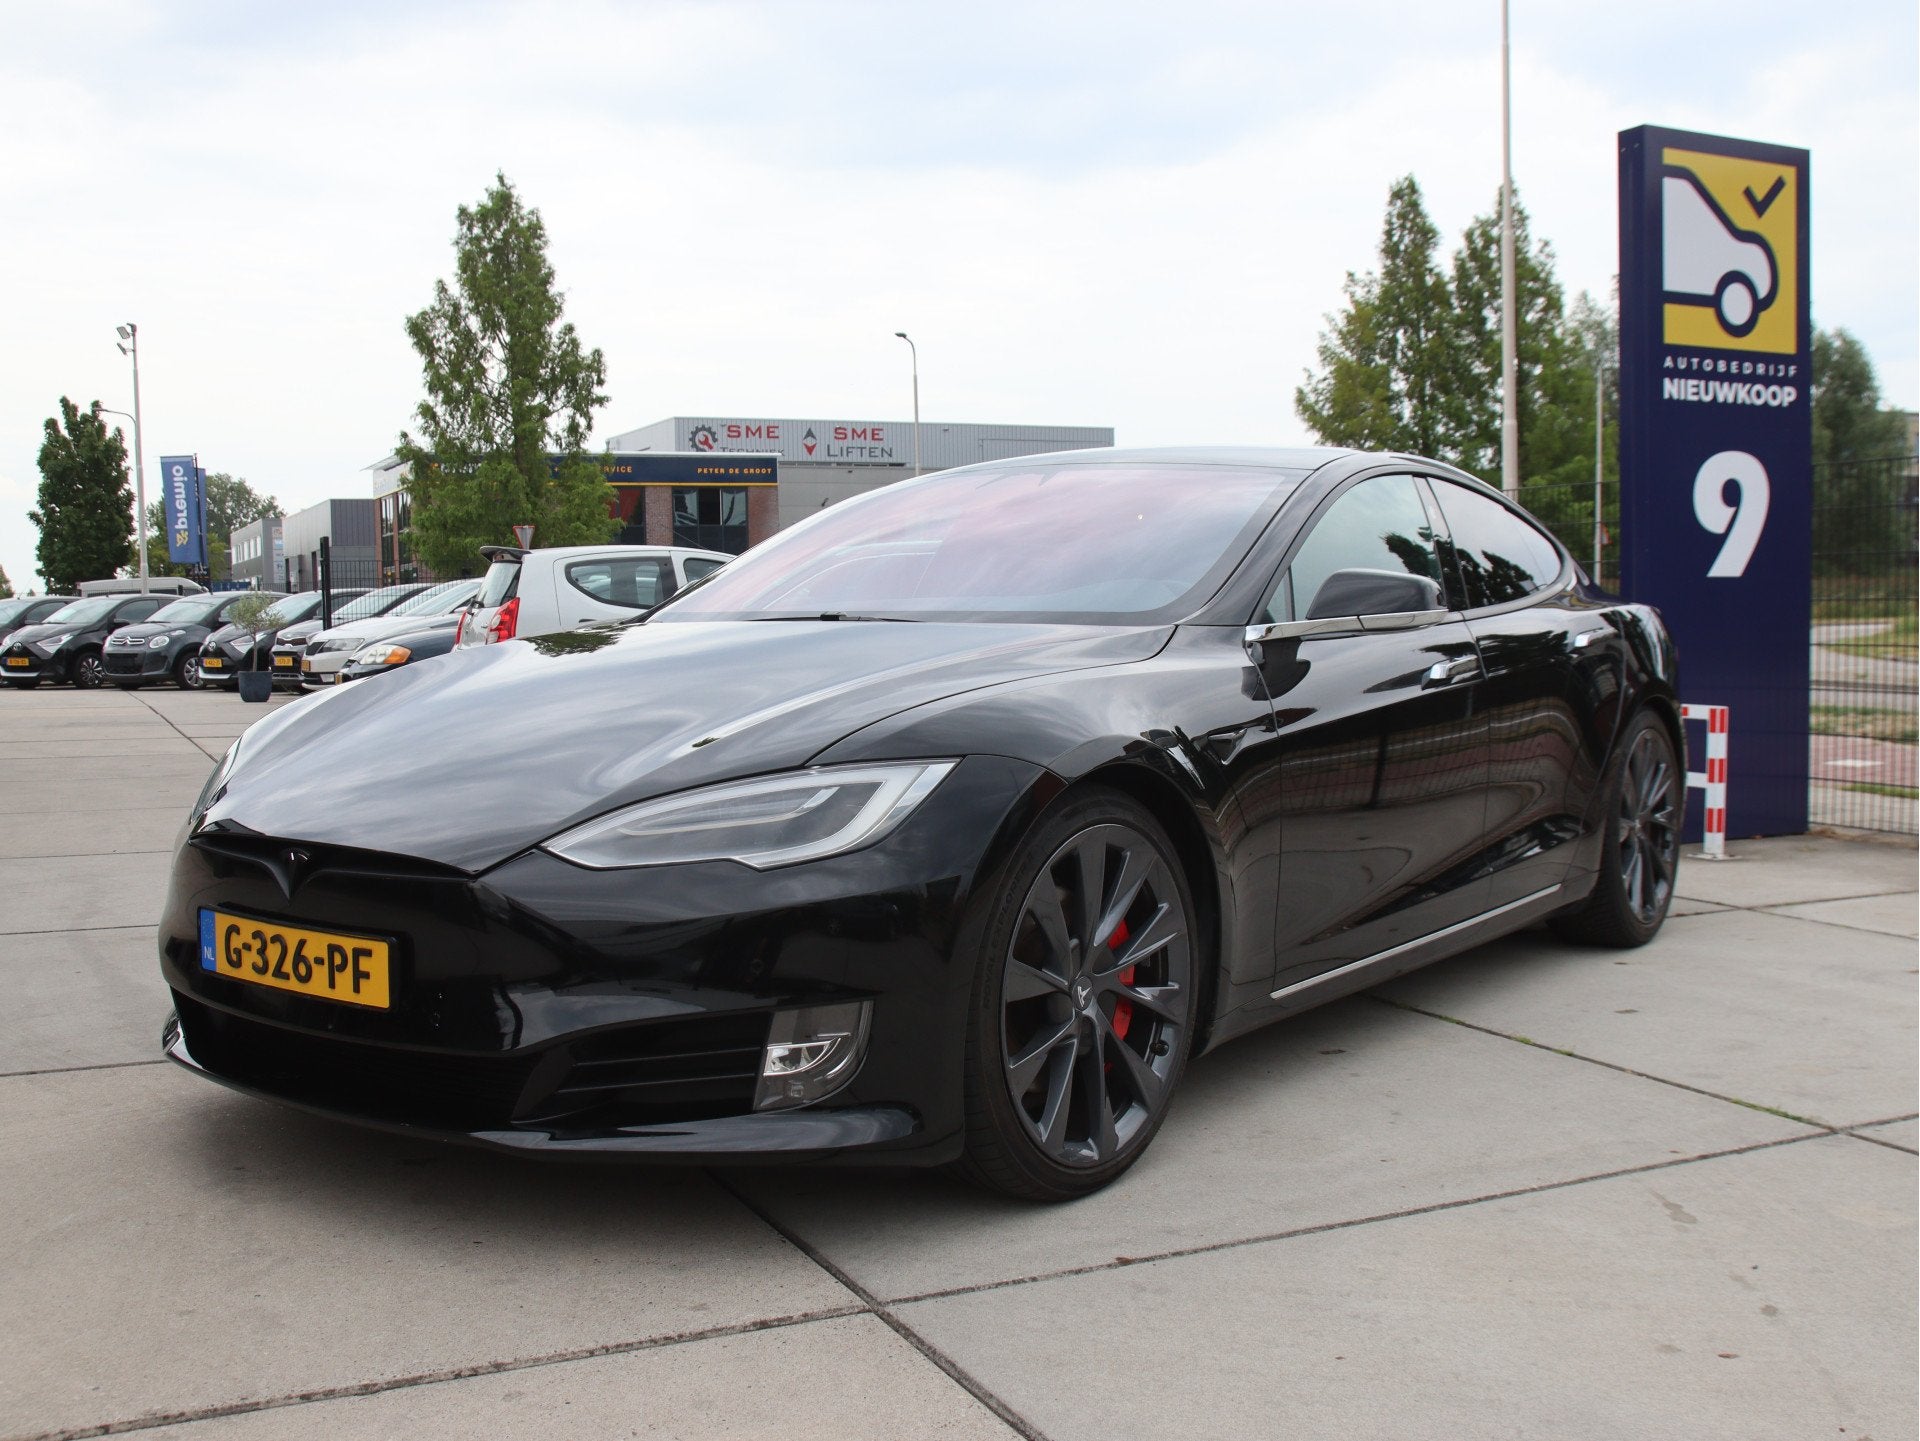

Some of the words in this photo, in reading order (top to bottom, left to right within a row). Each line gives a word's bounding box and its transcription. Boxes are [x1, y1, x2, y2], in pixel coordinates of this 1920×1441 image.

[1663, 355, 1798, 378] AUTOBEDRIJF
[1662, 377, 1798, 407] NIEUWKOOP
[726, 424, 780, 439] SME
[833, 427, 884, 441] SME
[826, 444, 893, 458] LIFTEN
[1692, 450, 1771, 578] 9
[203, 945, 215, 962] NL
[223, 923, 373, 994] G-326-PF
